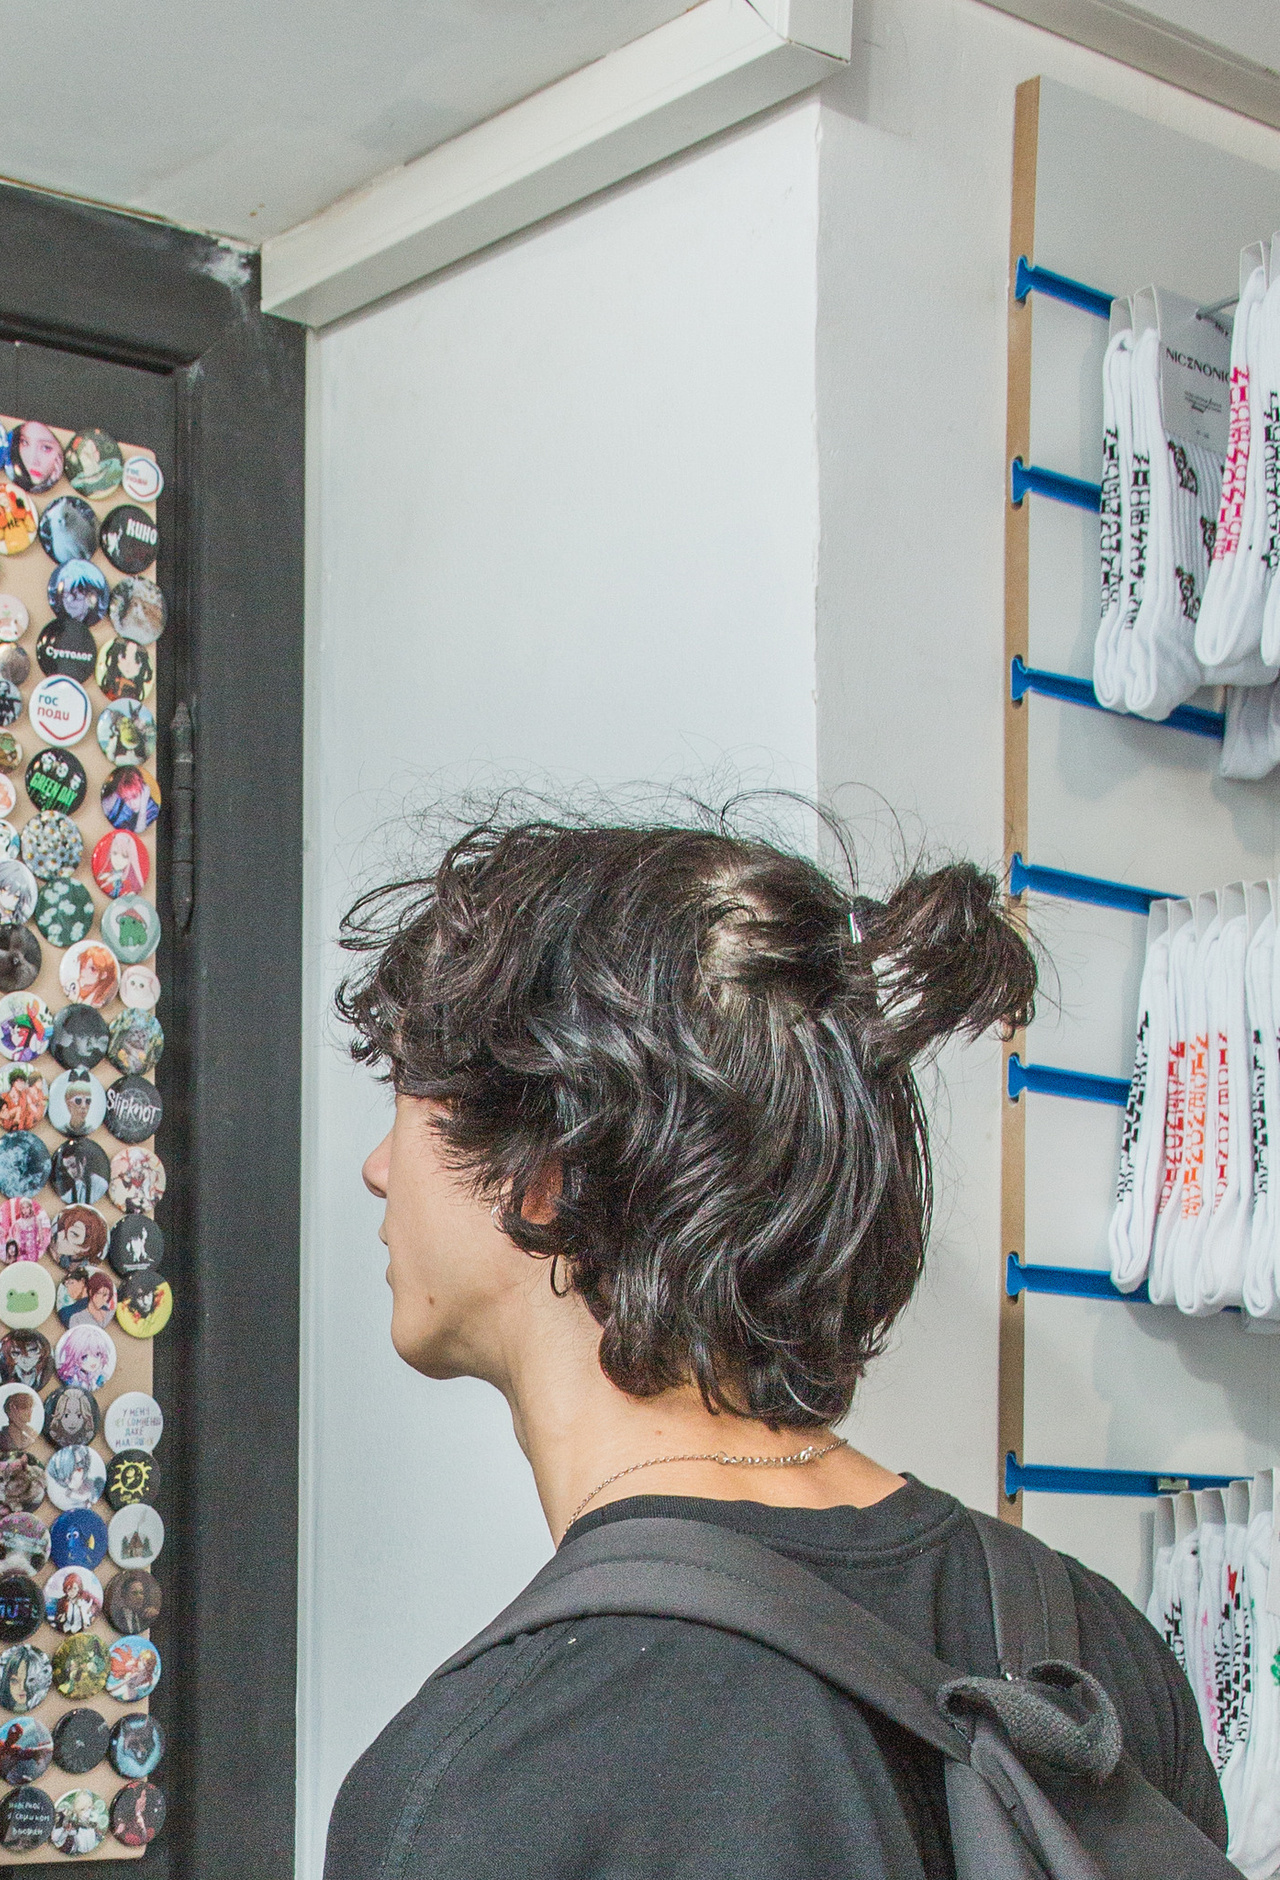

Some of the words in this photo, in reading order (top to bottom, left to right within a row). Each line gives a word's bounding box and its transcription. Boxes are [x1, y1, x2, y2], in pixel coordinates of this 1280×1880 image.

[44, 645, 94, 663] Суетолог
[30, 772, 61, 800] GREEN
[57, 784, 79, 807] DAY
